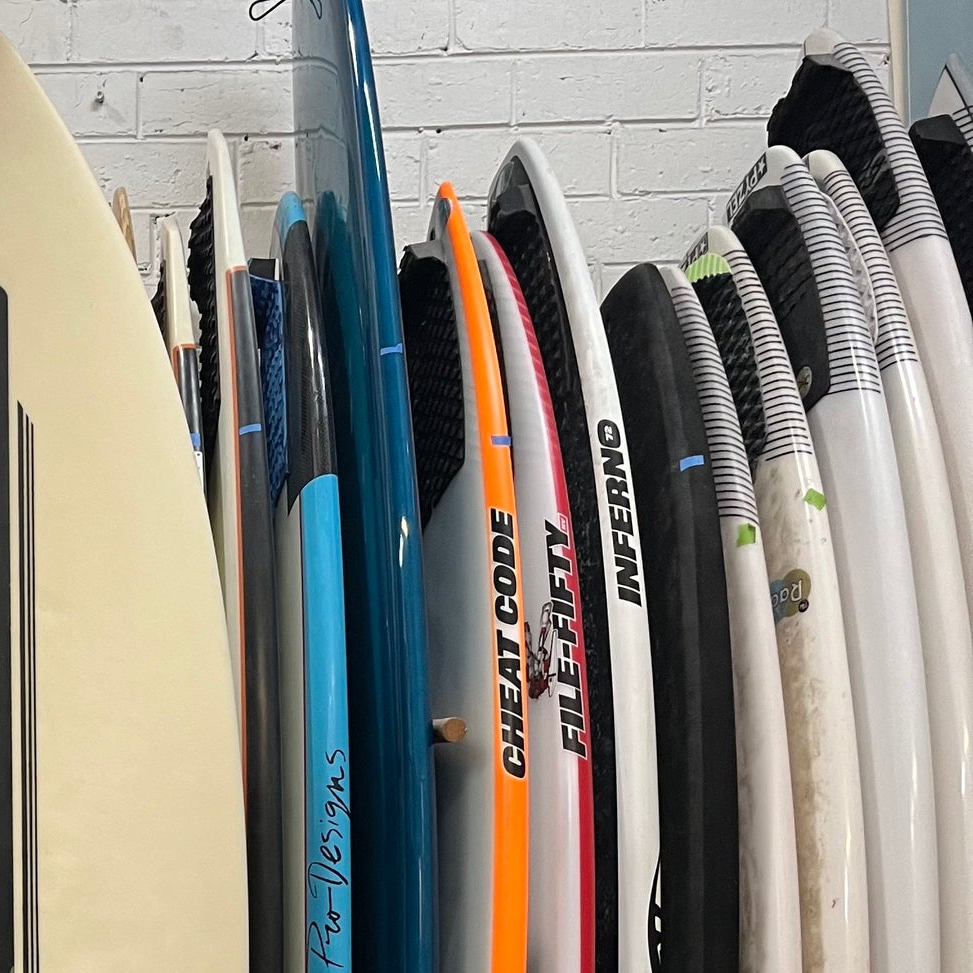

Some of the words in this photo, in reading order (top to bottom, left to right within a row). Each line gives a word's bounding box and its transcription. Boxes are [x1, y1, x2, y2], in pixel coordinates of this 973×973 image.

[728, 168, 757, 216] PYZEL
[604, 425, 614, 441] 72
[491, 508, 519, 626] CODE
[597, 419, 643, 607] INFERNO
[496, 629, 526, 779] CHEAT
[544, 518, 588, 759] FILE-FIFTY
